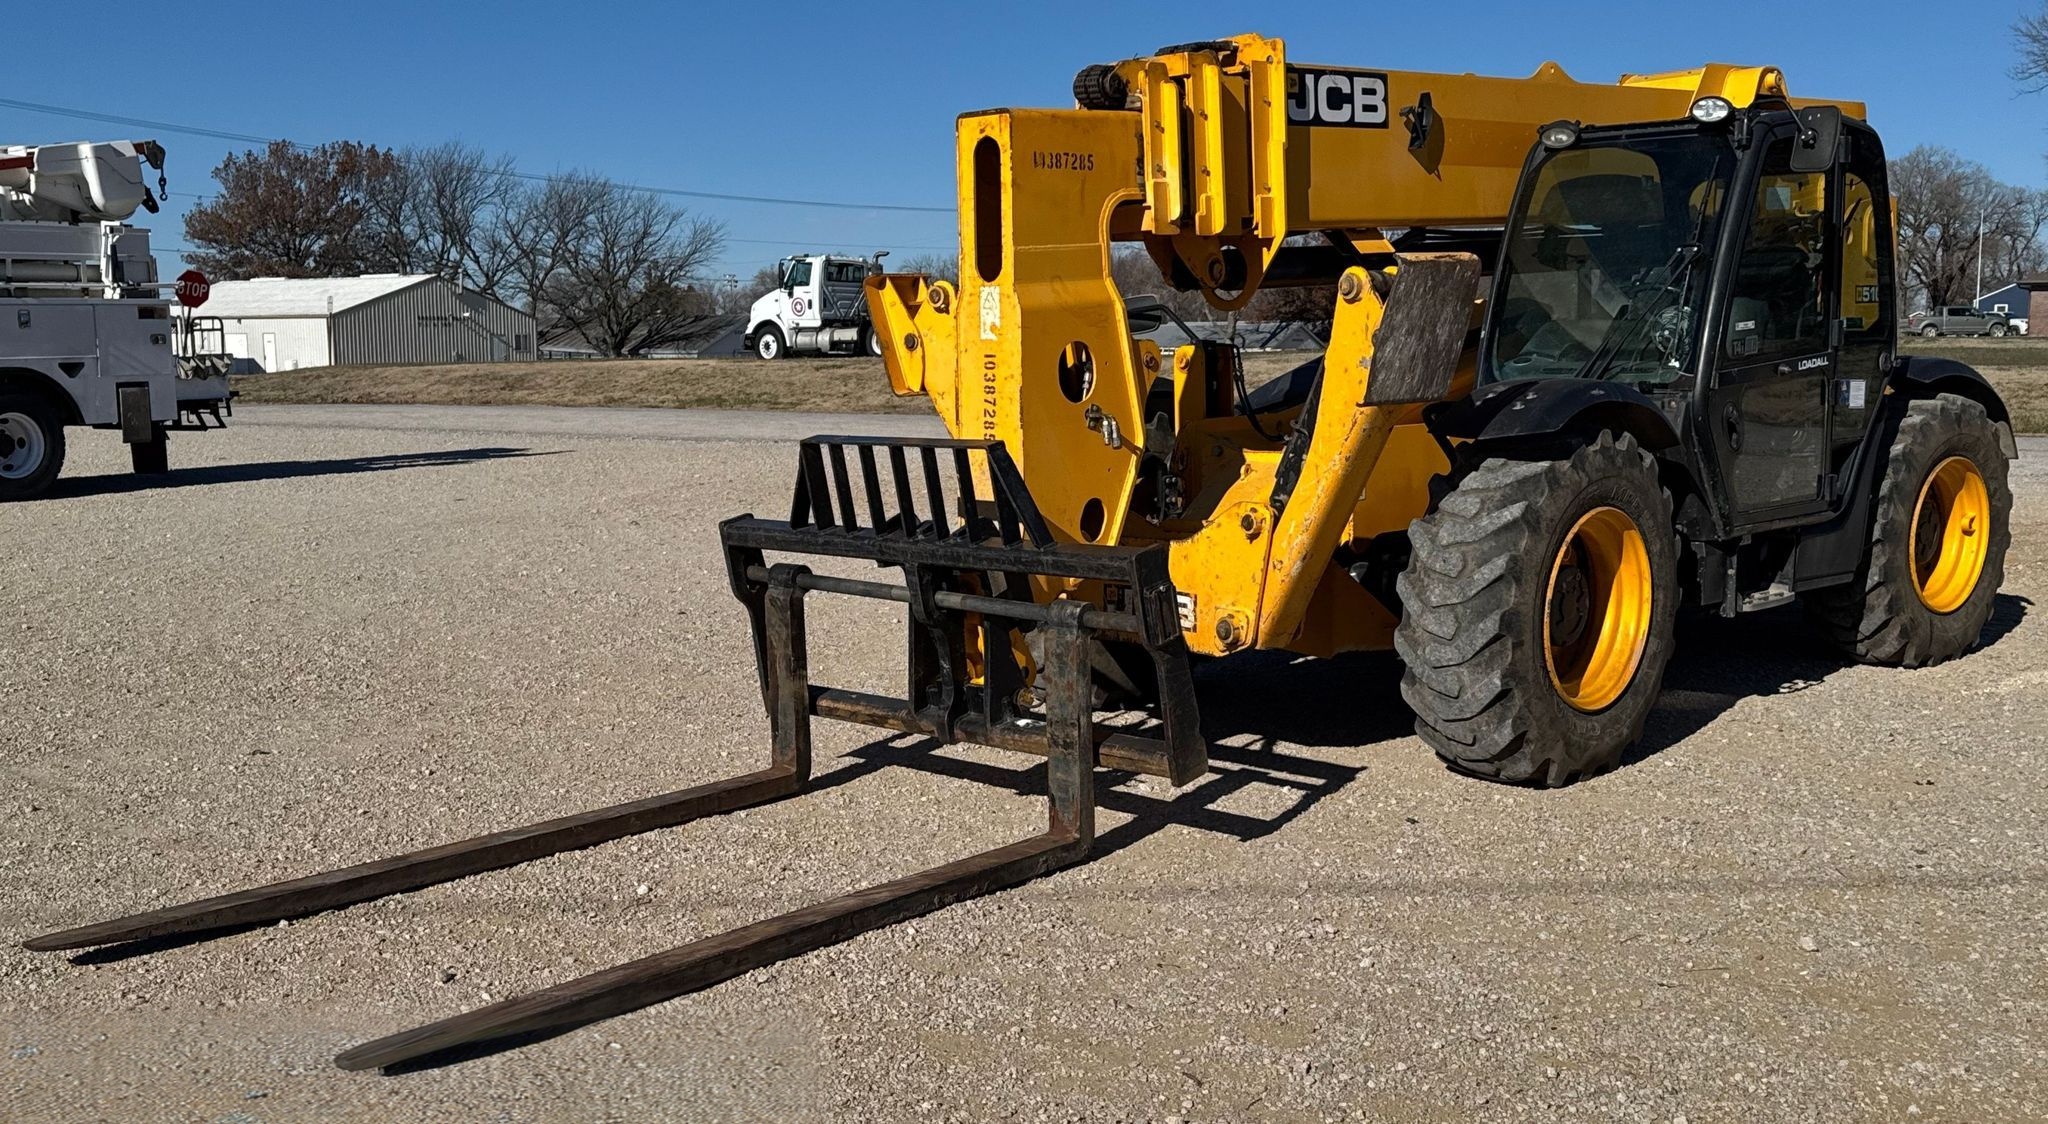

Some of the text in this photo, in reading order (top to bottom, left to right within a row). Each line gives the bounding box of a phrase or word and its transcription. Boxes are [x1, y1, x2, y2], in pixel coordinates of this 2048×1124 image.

[1288, 73, 1386, 123] JCB
[177, 280, 208, 298] STOP
[1798, 356, 1829, 371] LOADALL
